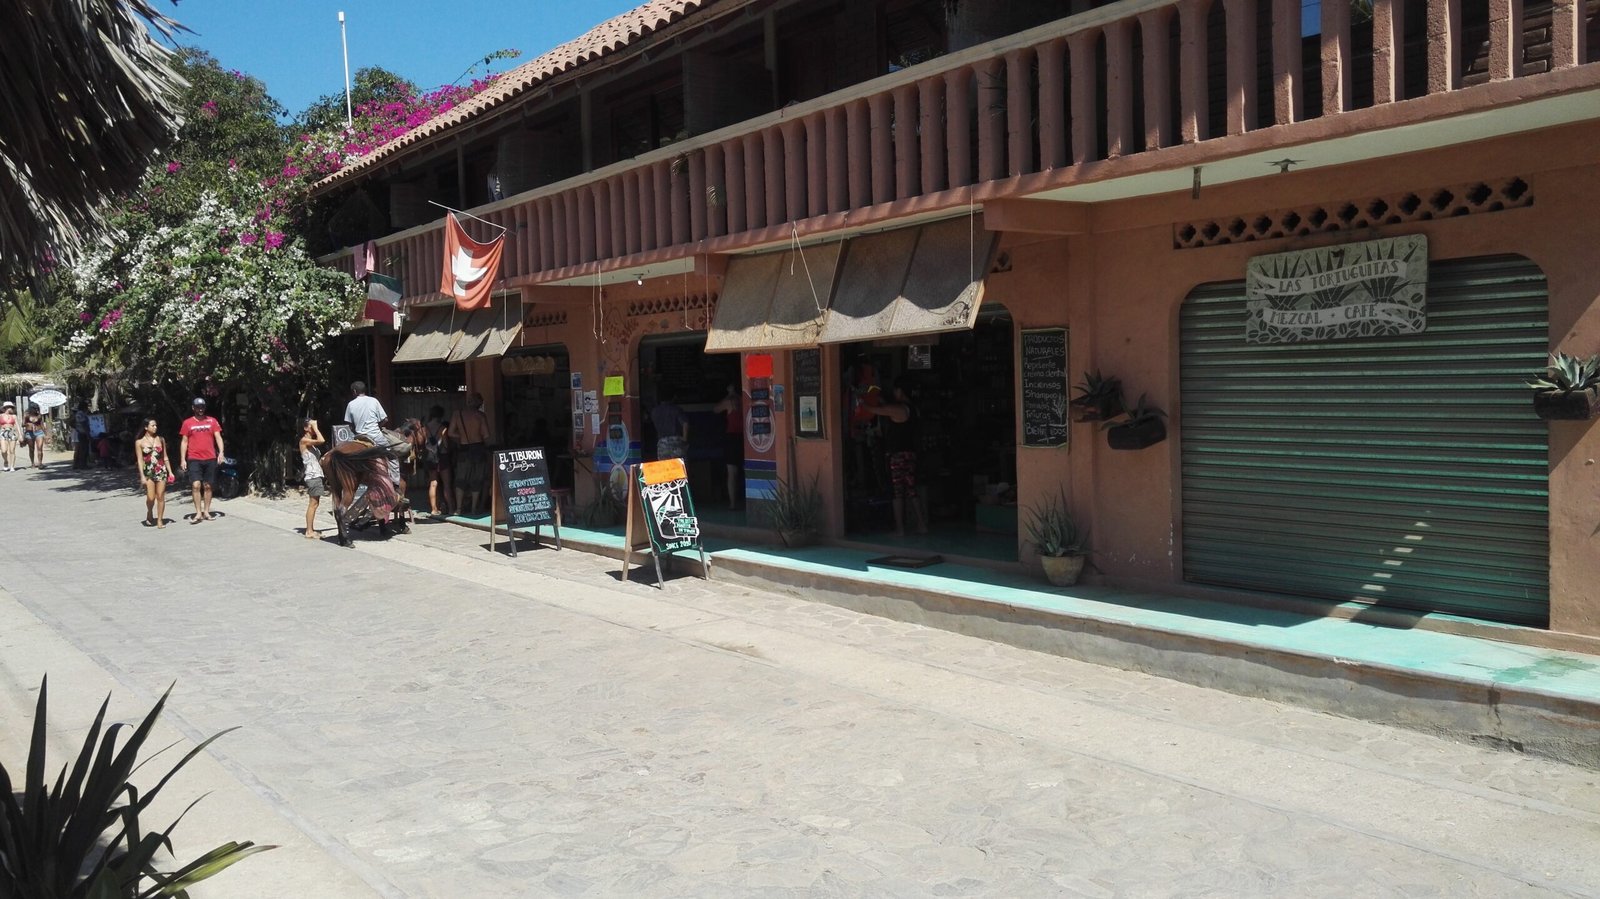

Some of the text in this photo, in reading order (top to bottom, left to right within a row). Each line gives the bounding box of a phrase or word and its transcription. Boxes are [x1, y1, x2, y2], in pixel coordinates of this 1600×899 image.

[1278, 260, 1400, 293] LAS TORTUGUITAS
[1269, 309, 1323, 325] MEZCAL
[1025, 346, 1065, 357] NATURALES
[1025, 389, 1058, 400] Shampoo
[499, 450, 543, 463] EL TIBURON
[521, 460, 536, 471] Bar
[509, 496, 526, 505] COLD
